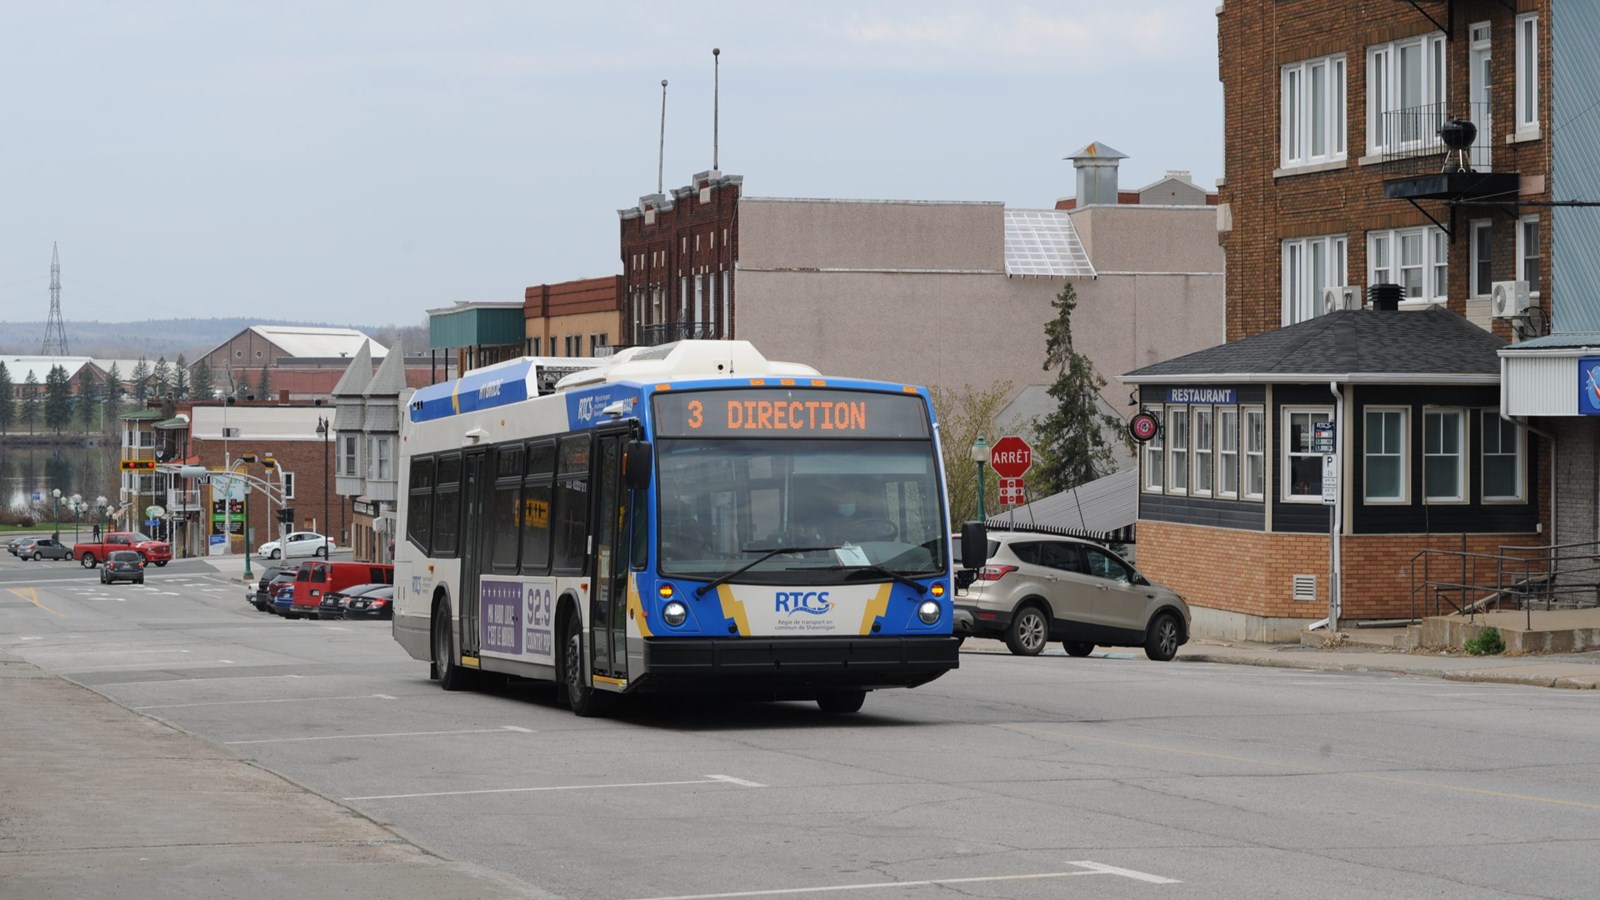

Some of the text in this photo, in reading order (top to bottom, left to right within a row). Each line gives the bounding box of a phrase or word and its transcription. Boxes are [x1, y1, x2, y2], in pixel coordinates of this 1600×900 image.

[1171, 389, 1231, 402] RESTAURANT
[687, 400, 866, 430] 3 DIRECTION
[993, 449, 1029, 464] ARRÊT
[527, 588, 551, 626] 92.9
[775, 591, 831, 614] RTCS
